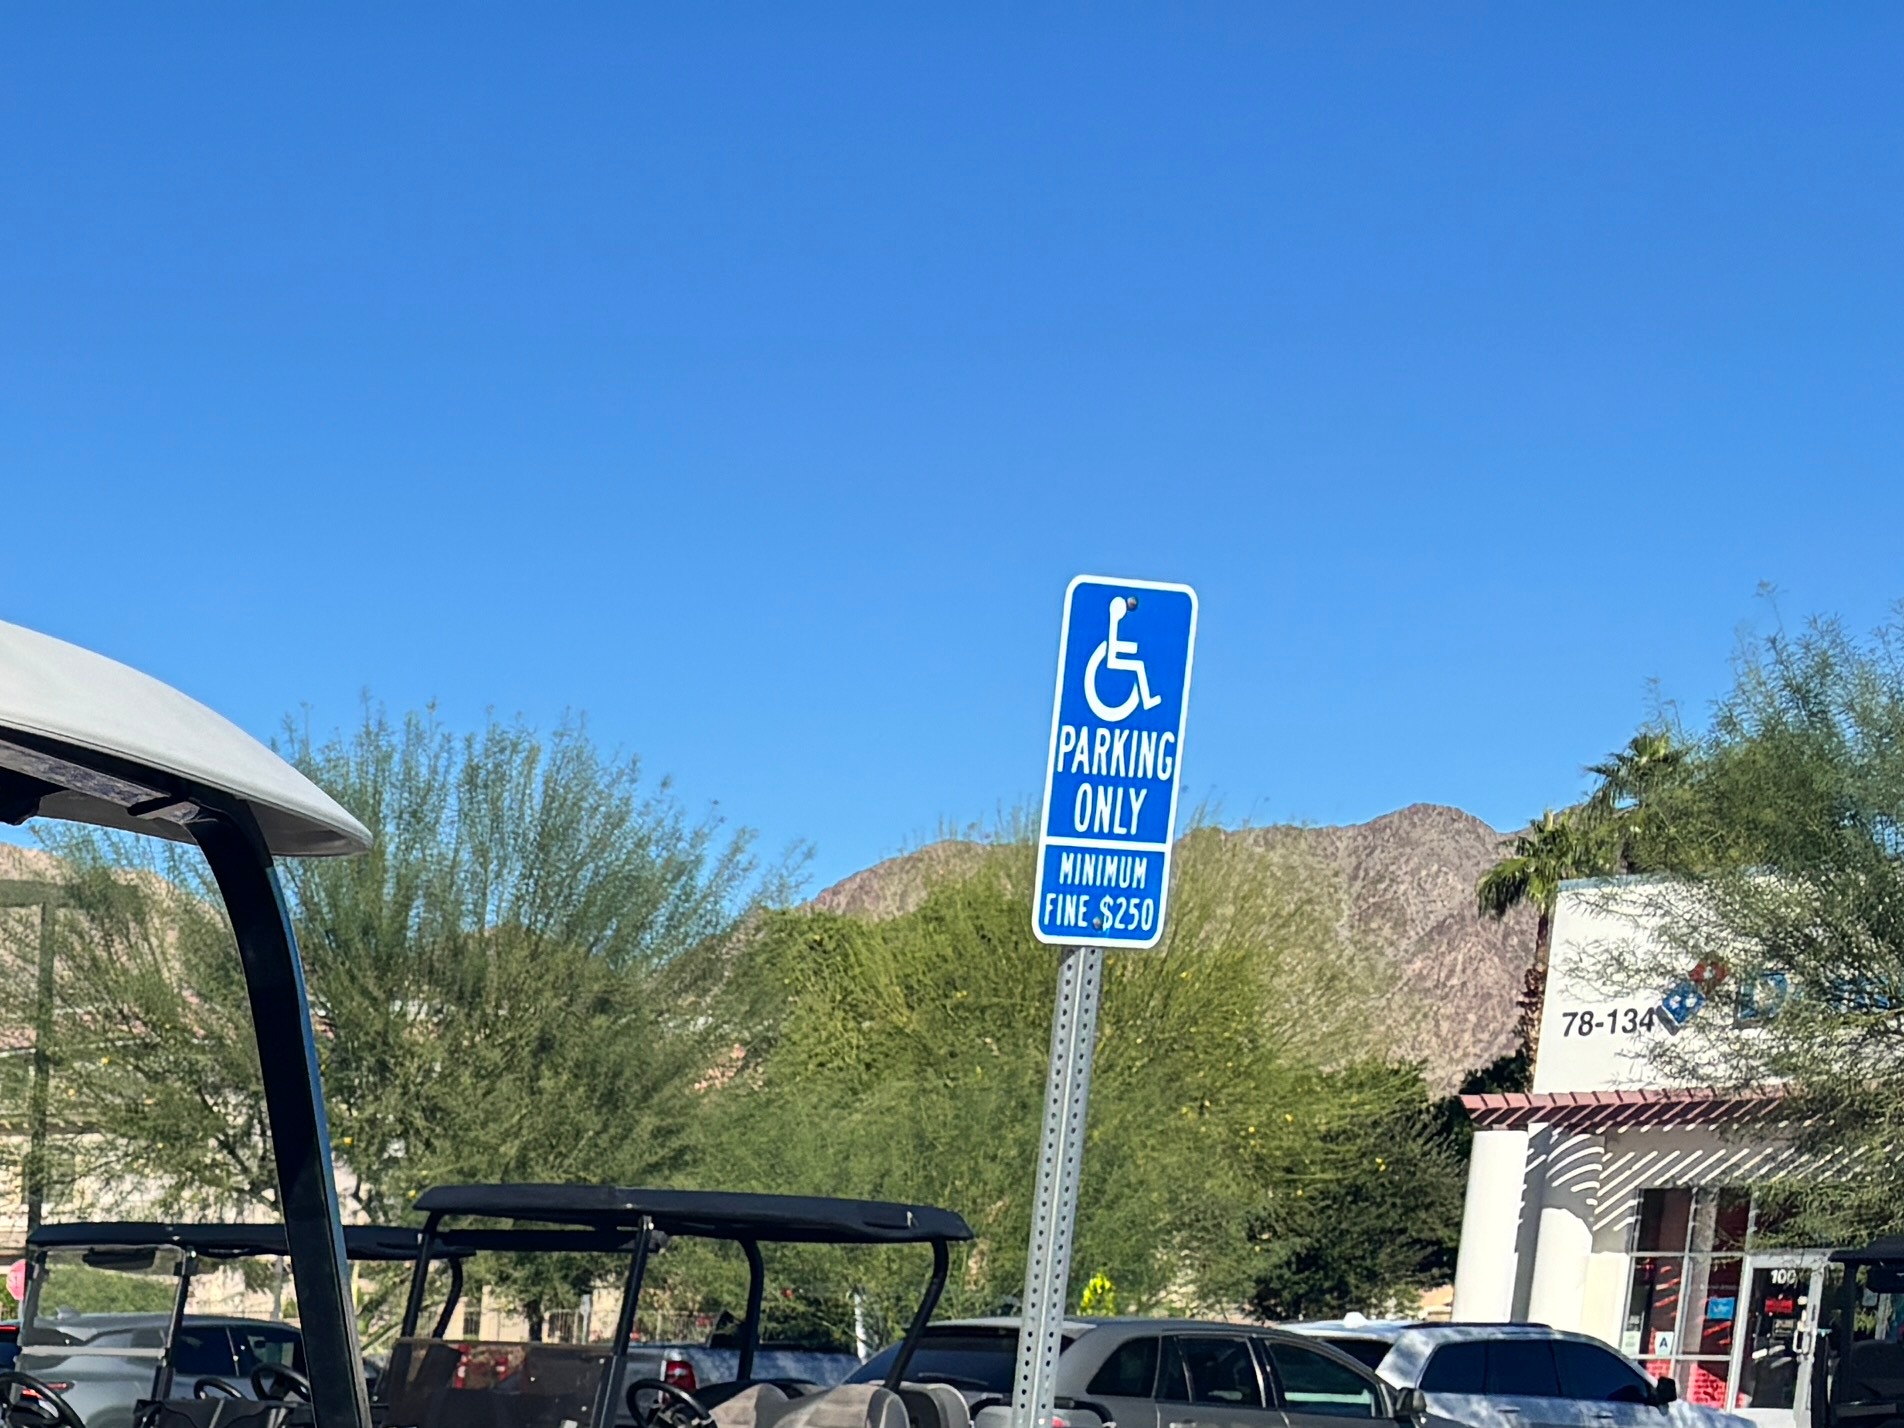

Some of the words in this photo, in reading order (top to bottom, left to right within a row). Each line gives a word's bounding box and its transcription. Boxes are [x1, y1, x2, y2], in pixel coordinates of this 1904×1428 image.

[1057, 725, 1175, 781] PARKING
[1074, 782, 1147, 835] ONLY
[1059, 852, 1147, 889] MINIMUM
[1044, 893, 1090, 927] FINE
[1099, 895, 1154, 932] $250
[1562, 1007, 1655, 1037] 78-134
